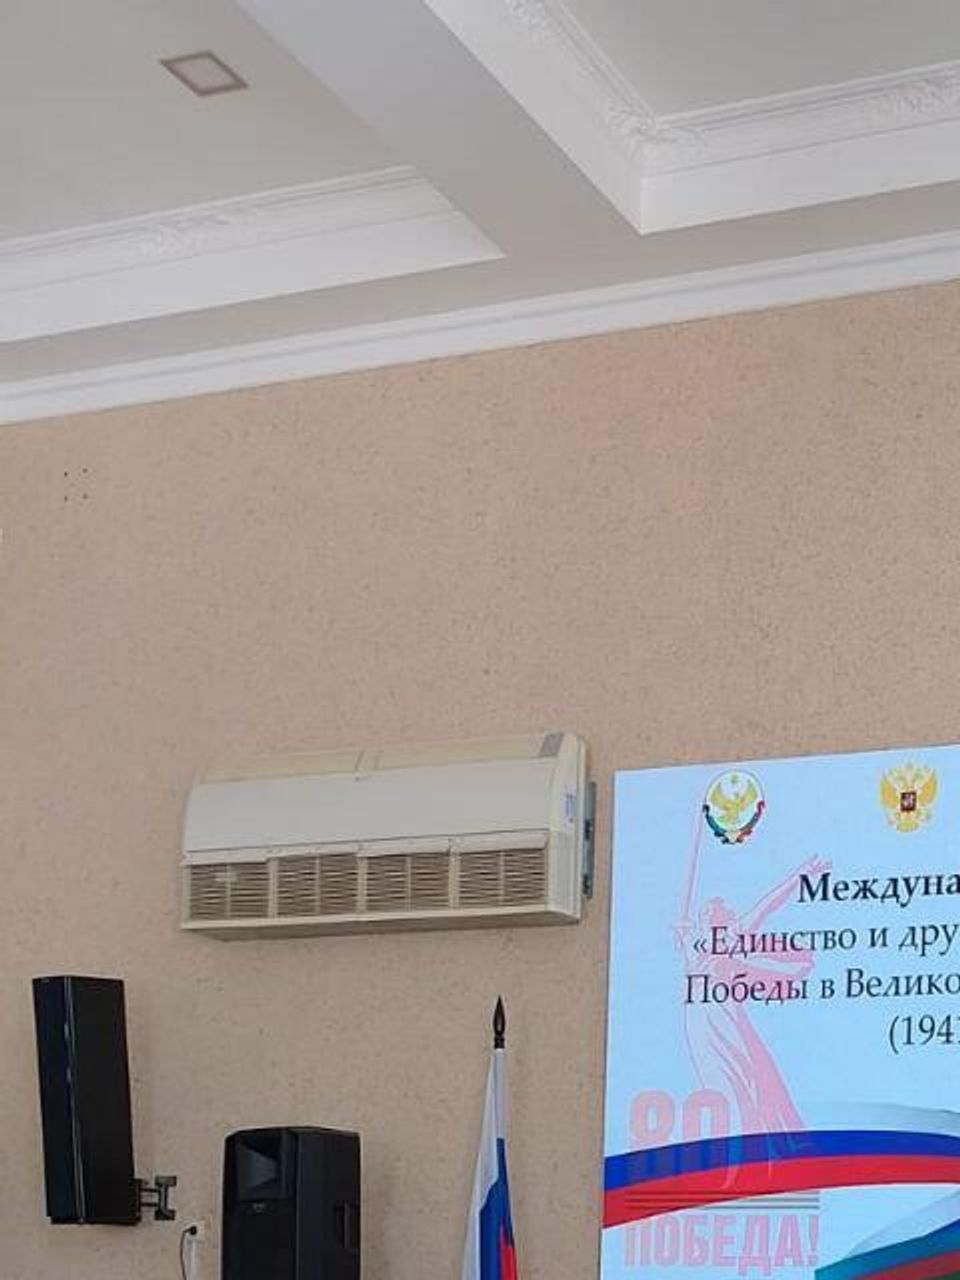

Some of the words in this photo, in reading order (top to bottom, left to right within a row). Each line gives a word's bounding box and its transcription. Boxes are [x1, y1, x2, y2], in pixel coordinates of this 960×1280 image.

[693, 925, 857, 957] «Единство
[868, 927, 889, 948] и
[685, 974, 808, 1004] Победы
[820, 980, 836, 998] в
[625, 1214, 819, 1277] ПОБЕДА!
